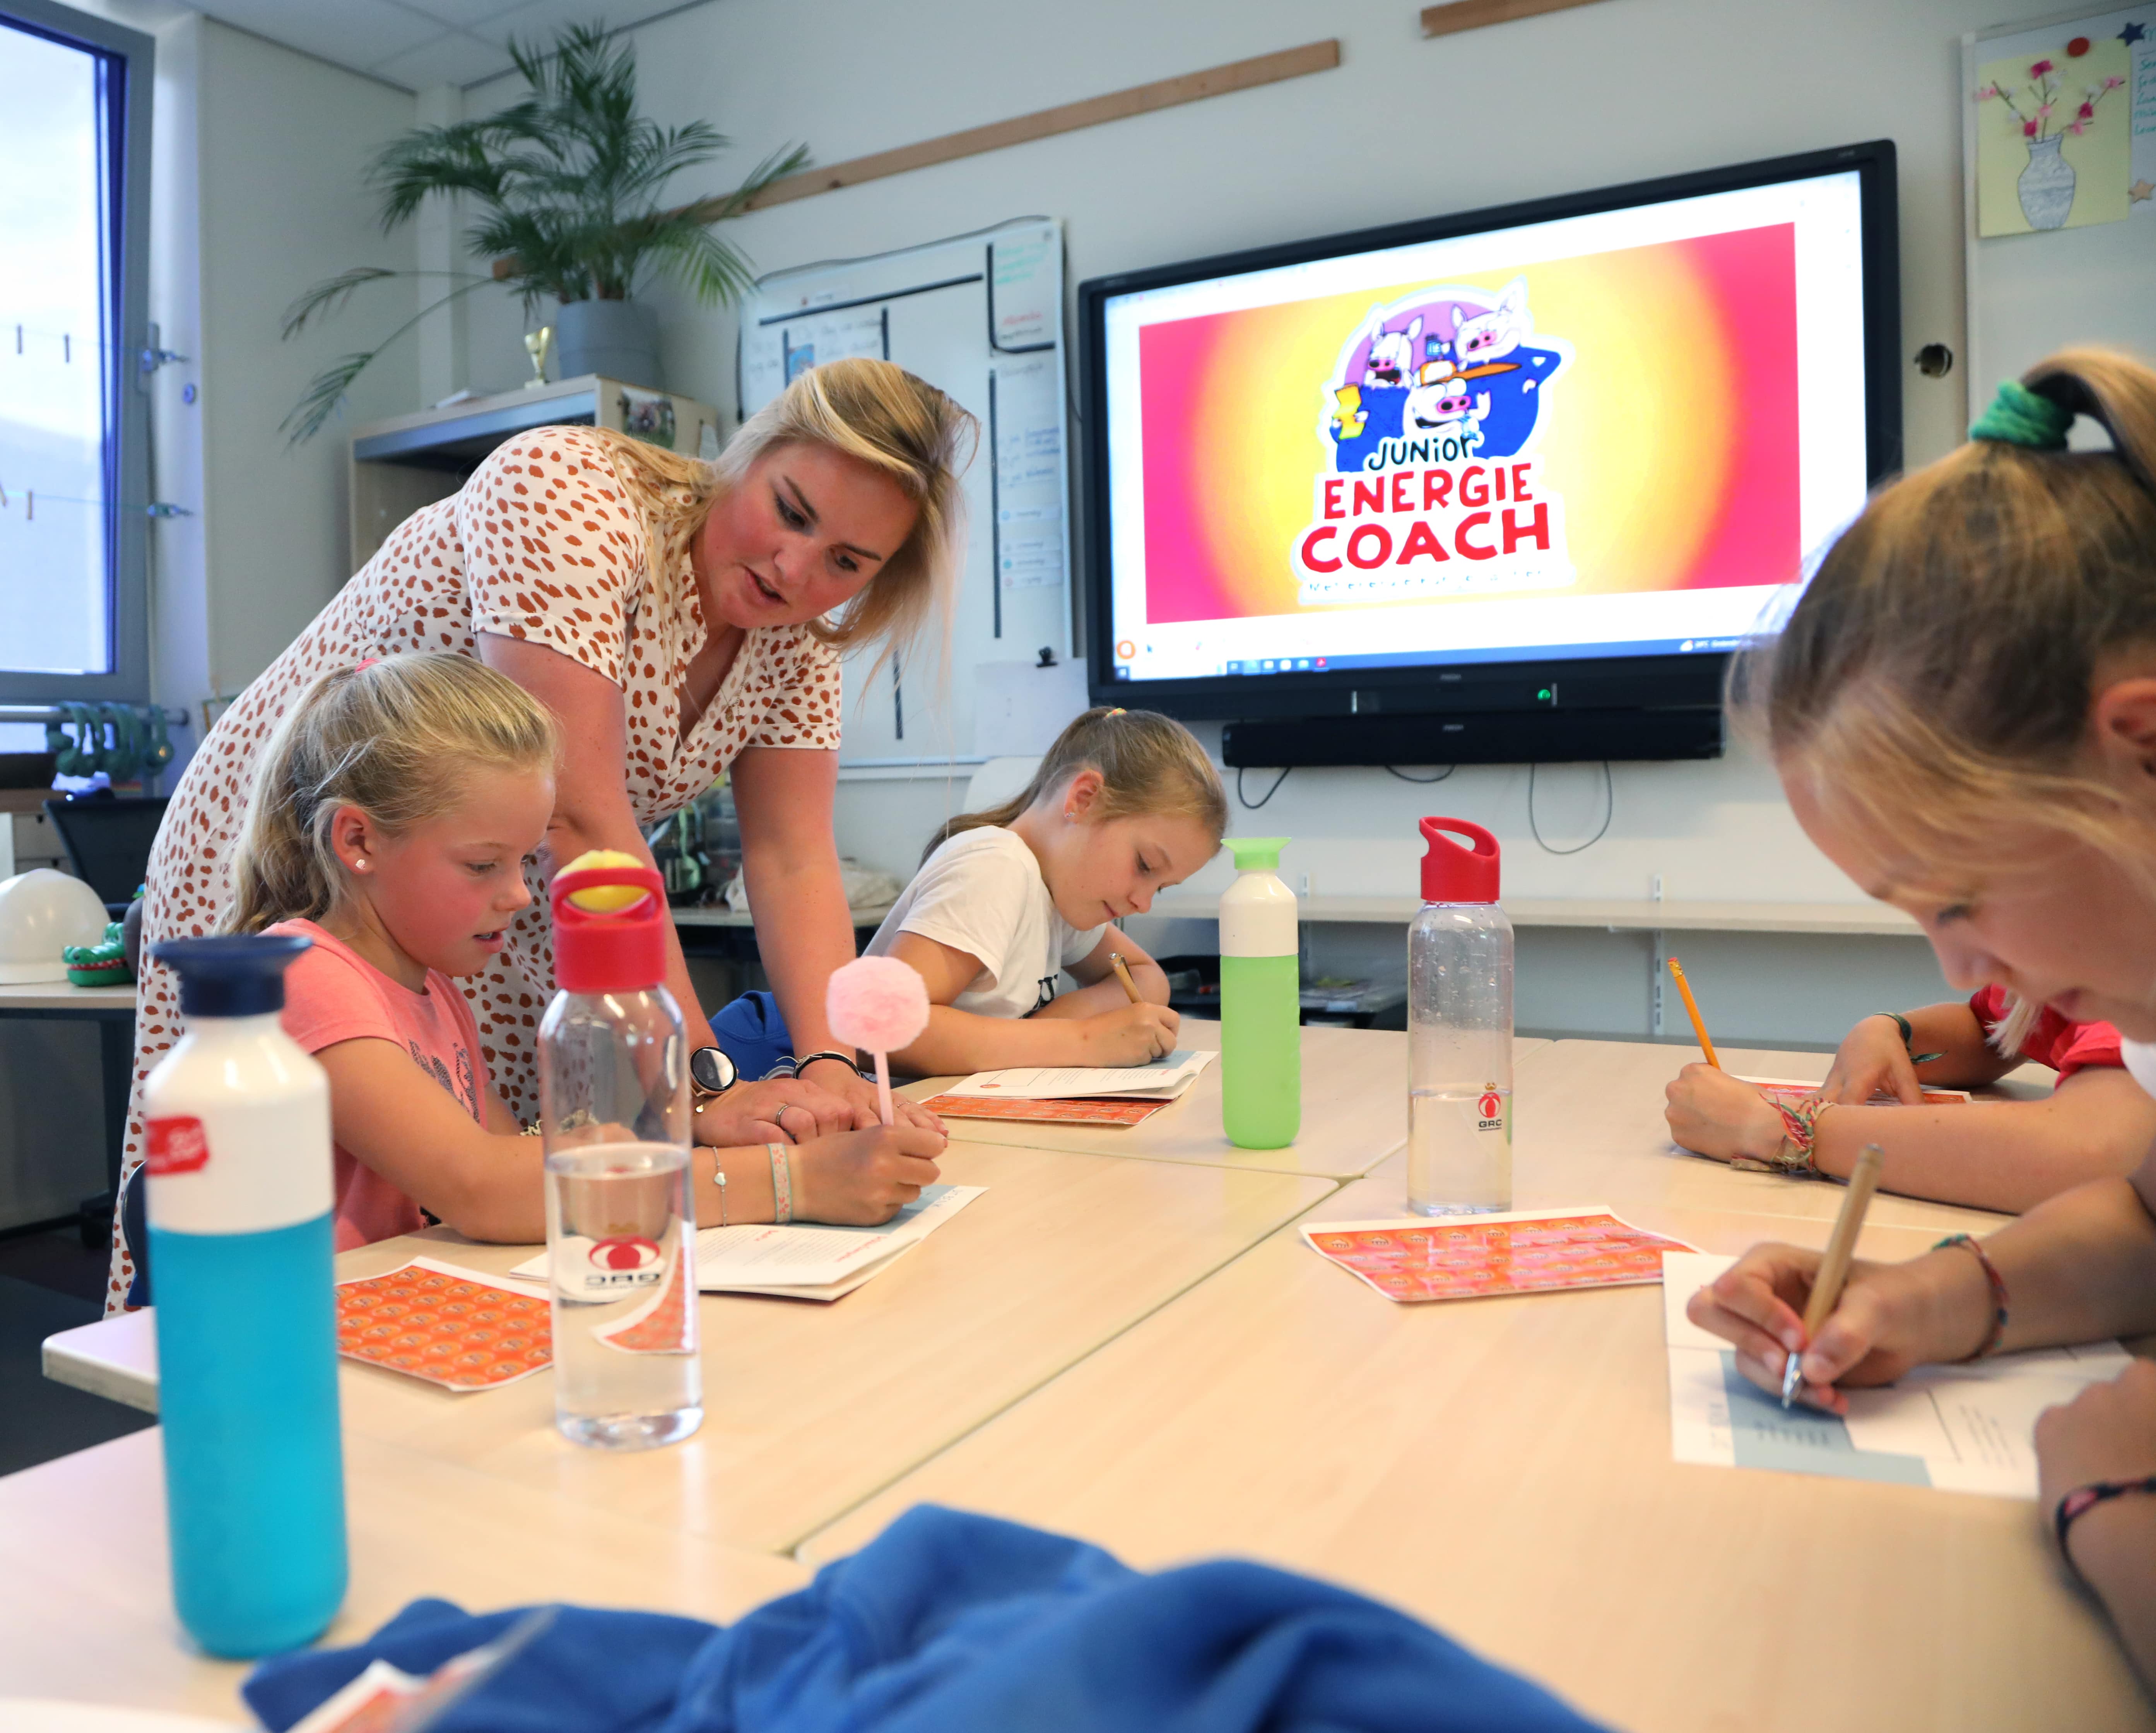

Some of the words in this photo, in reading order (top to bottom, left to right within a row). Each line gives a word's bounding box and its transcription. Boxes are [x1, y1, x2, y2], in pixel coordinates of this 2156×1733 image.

[1324, 462, 1533, 520] ENERGIE
[1301, 502, 1550, 573] COACH
[1479, 1119, 1502, 1128] GRC
